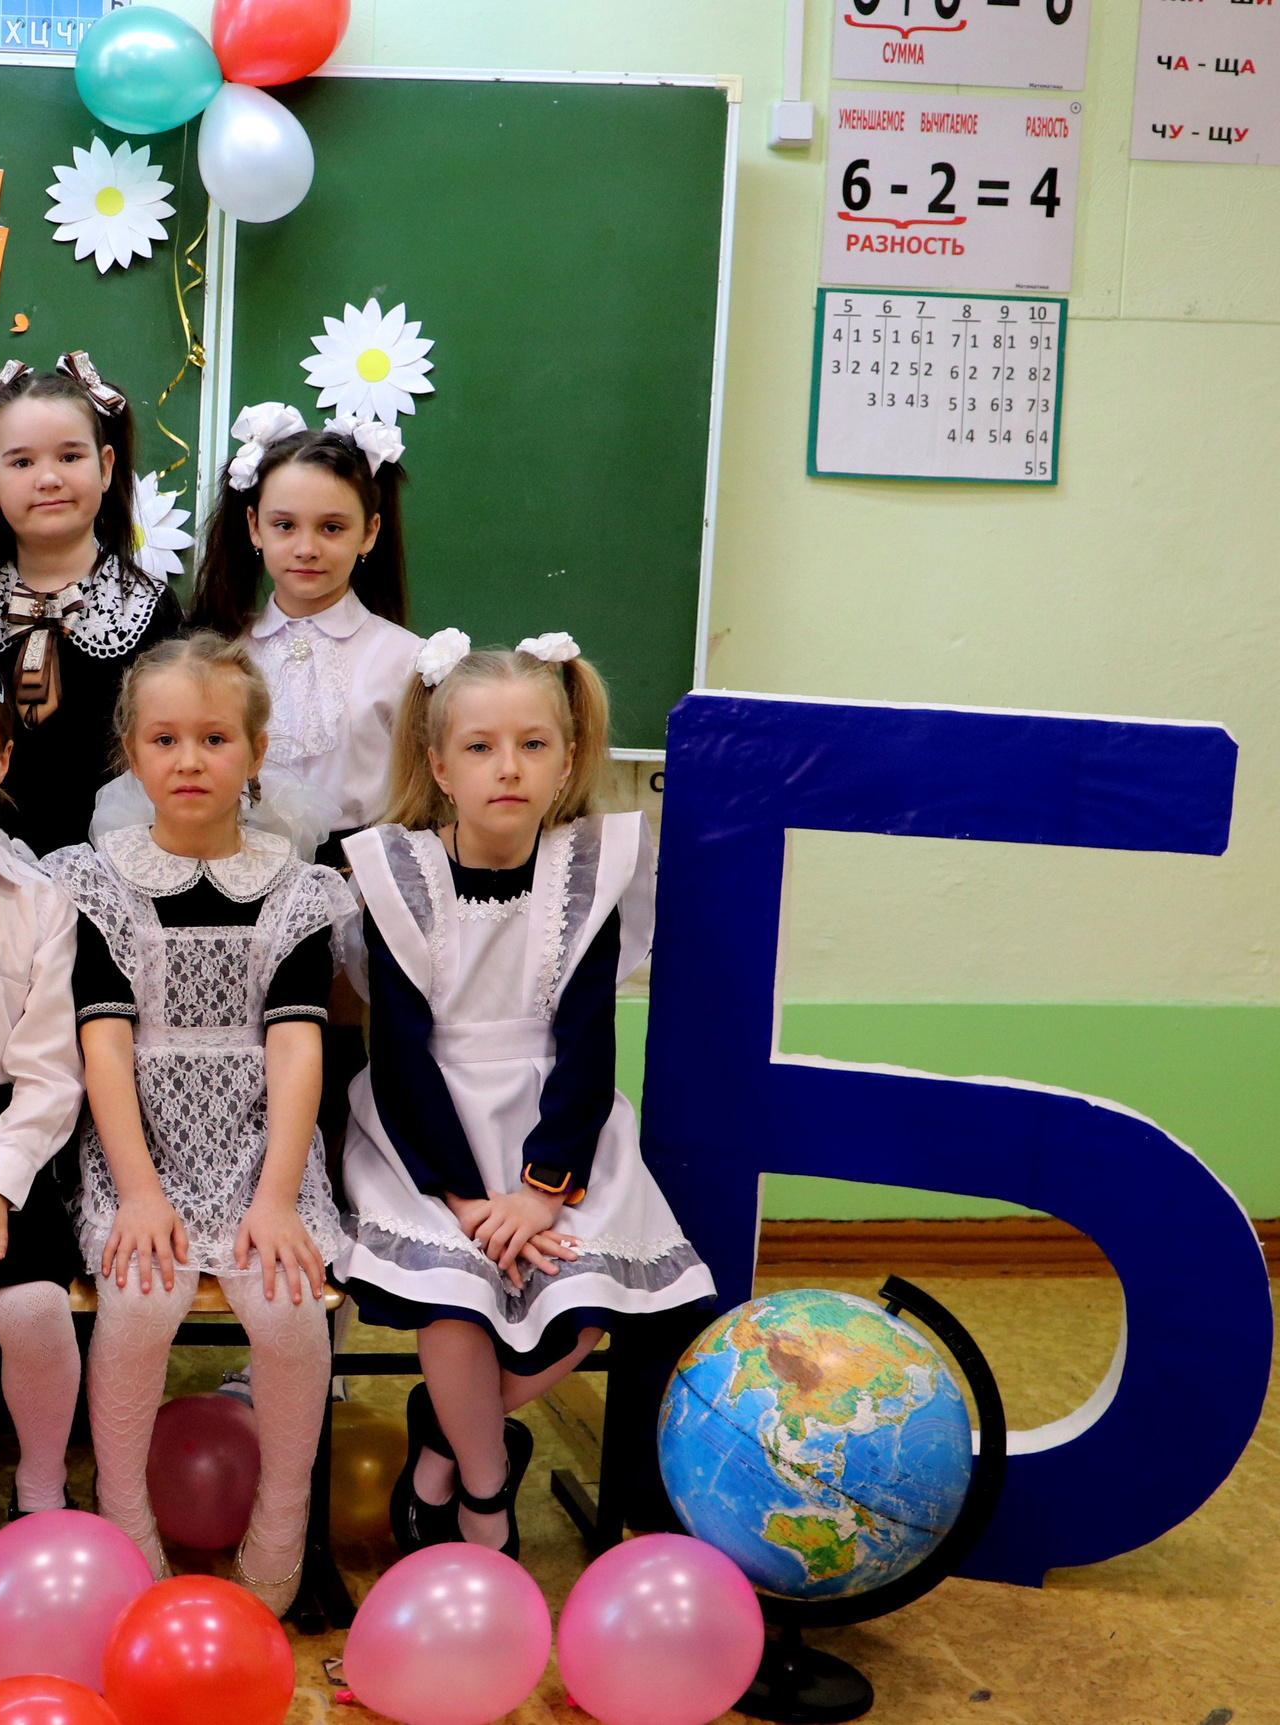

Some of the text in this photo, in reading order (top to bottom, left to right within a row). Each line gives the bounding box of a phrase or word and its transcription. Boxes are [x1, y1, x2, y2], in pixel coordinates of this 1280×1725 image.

[882, 41, 925, 65] СУММА
[1156, 55, 1190, 71] ЧА
[1215, 57, 1256, 76] ЩА
[838, 108, 1070, 138] УМЕНЬШАЕМОЕ ВЫЧИТАЕМОЕ РАЗНОСТЬ
[1151, 123, 1185, 139] ЧУ
[1208, 126, 1250, 145] ЩУ
[845, 233, 966, 257] РАЗНОСТЬ
[843, 298, 1047, 321] 5 6 7 8 9 10
[832, 328, 1052, 350] 4 1 5 1 6 1 7 1 8 1 9 1
[831, 359, 1051, 382] 3 2 4 2 5 2 6 2 7 2 8 2
[867, 392, 1050, 413] 3 3 4 3 5 3 6 3 7 3
[947, 428, 1048, 444] 4 4 5 4 6 4
[1024, 461, 1047, 476] 5 5
[641, 688, 1273, 1589] Б
